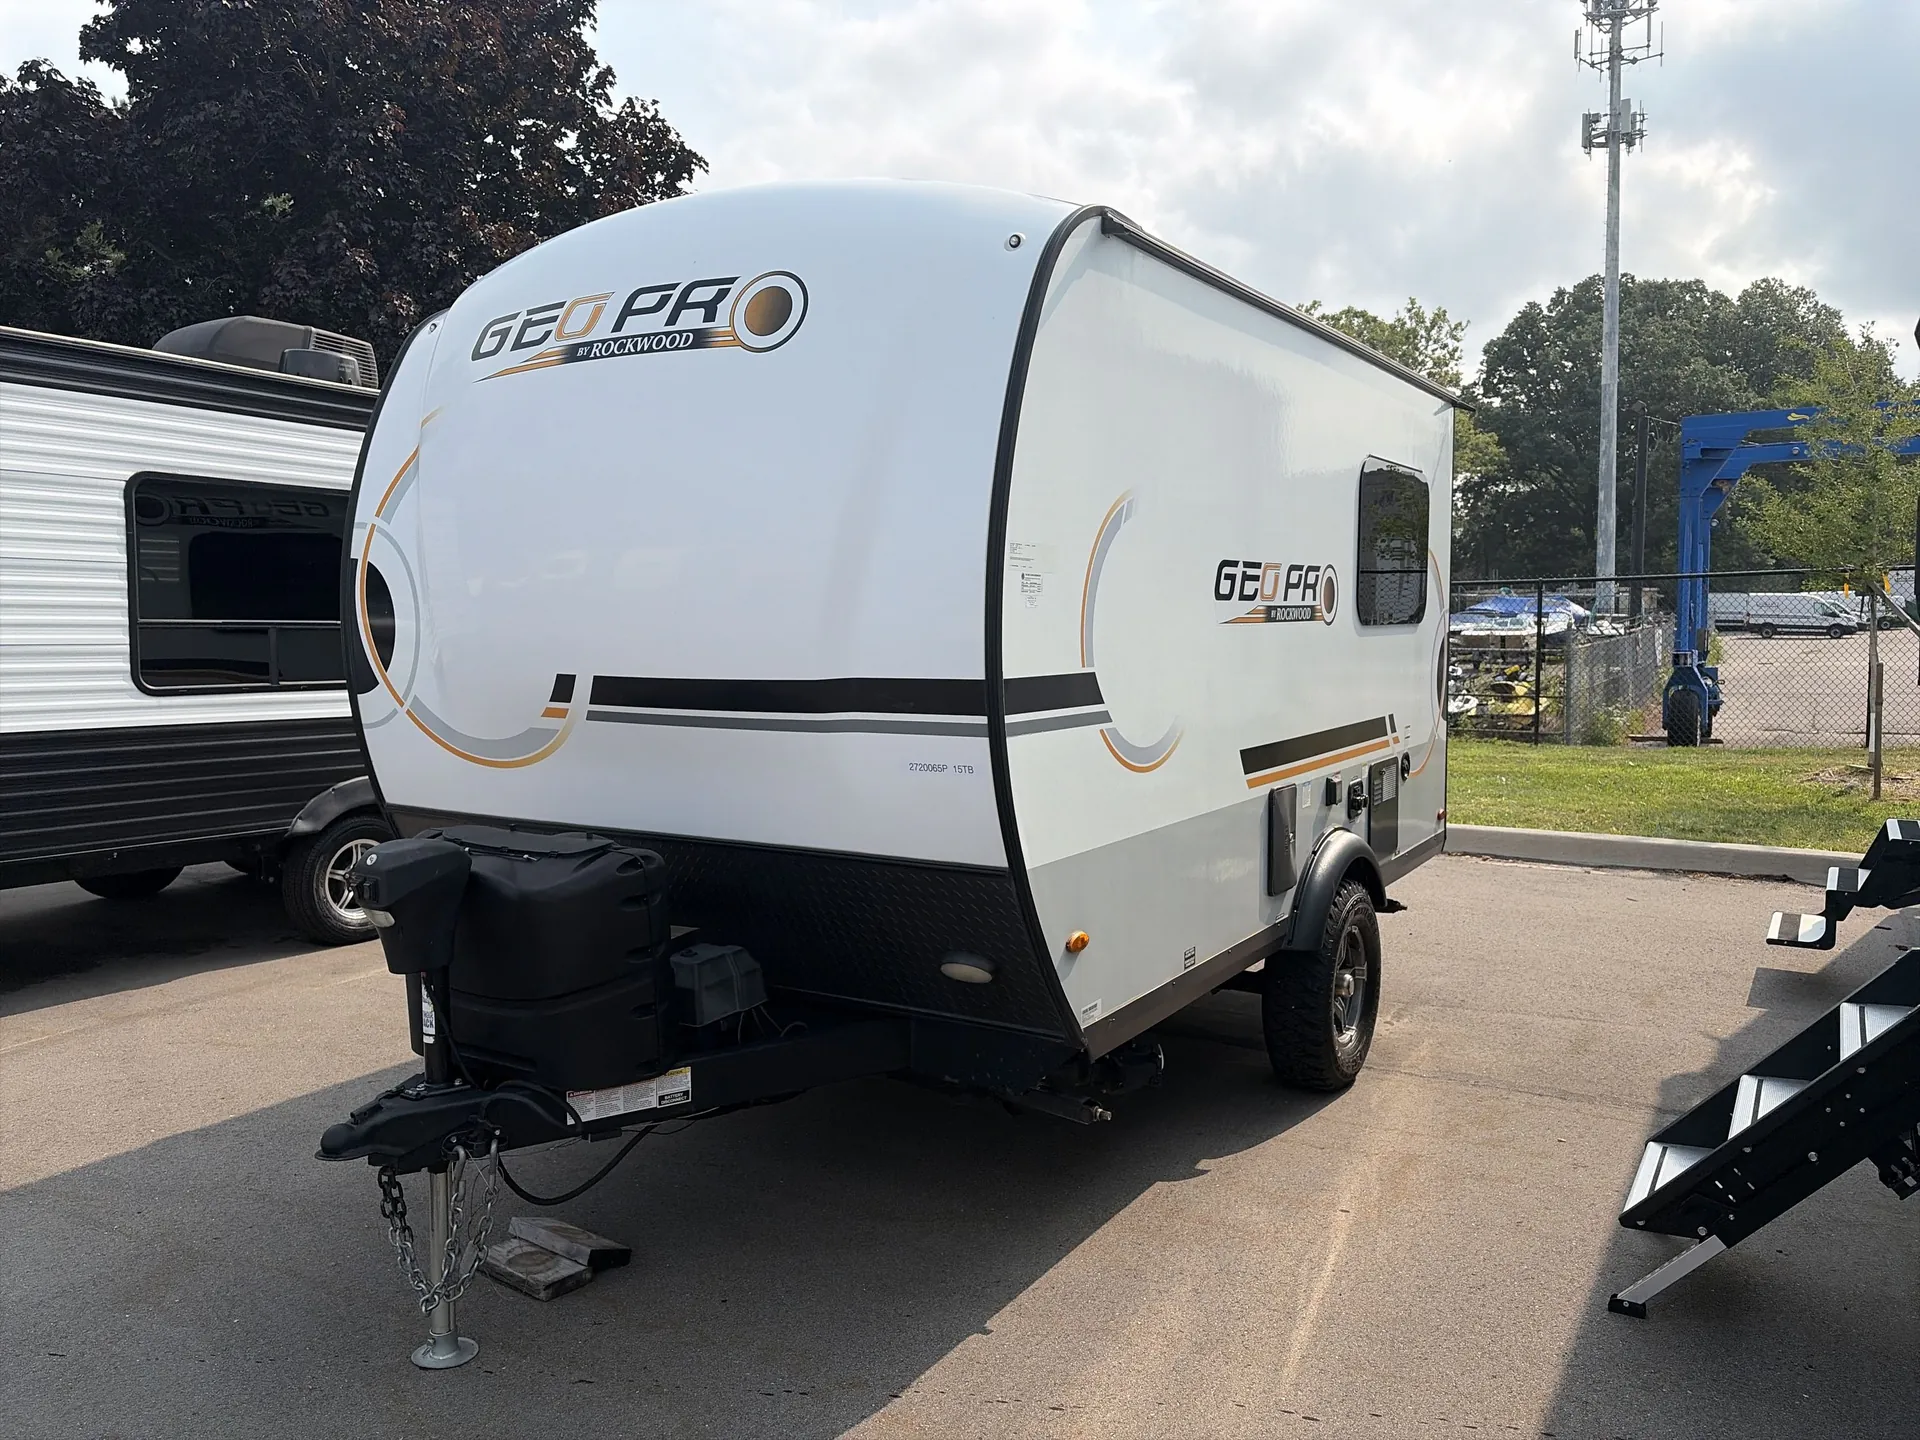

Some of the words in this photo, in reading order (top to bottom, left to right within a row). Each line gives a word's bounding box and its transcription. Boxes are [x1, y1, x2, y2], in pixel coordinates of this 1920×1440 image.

[471, 291, 615, 361] GEO
[577, 347, 591, 358] BY
[588, 332, 694, 359] ROCKWOOD
[1214, 559, 1282, 601] GEO
[1276, 607, 1311, 620] ROCKWOOD
[909, 763, 948, 773] 2720065P
[953, 765, 974, 774] 15TB
[661, 1096, 687, 1104] DISCONNECT
